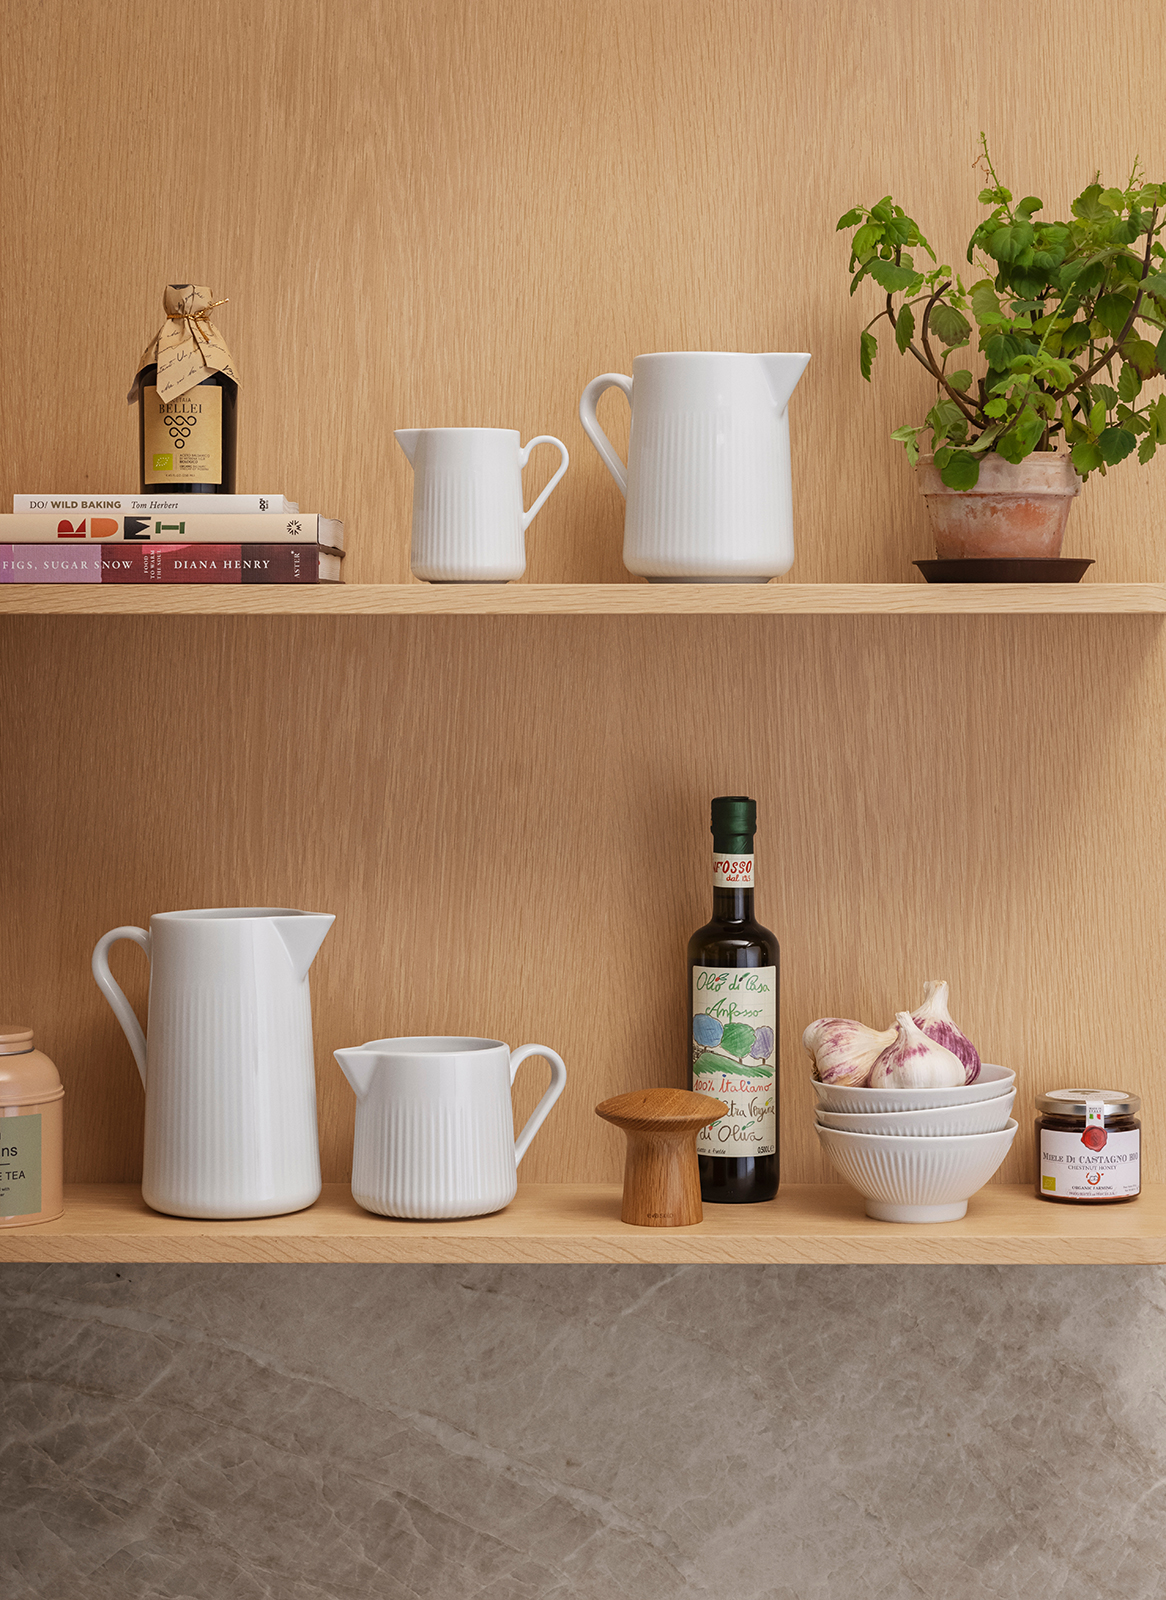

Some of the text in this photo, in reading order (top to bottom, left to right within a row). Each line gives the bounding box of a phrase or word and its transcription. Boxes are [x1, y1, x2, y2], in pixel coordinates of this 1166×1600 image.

[159, 404, 202, 414] BELLEI
[2, 560, 133, 570] FIGS, SUGAR SNOW
[174, 560, 270, 569] DIANA HENRY
[697, 971, 770, 993] Olio di Casa
[705, 997, 763, 1024] Anfosso
[693, 1078, 772, 1093] 100% Italiano
[748, 1097, 775, 1122] Vergine
[700, 1124, 763, 1142] di Oliva
[6, 1170, 26, 1180] TEA
